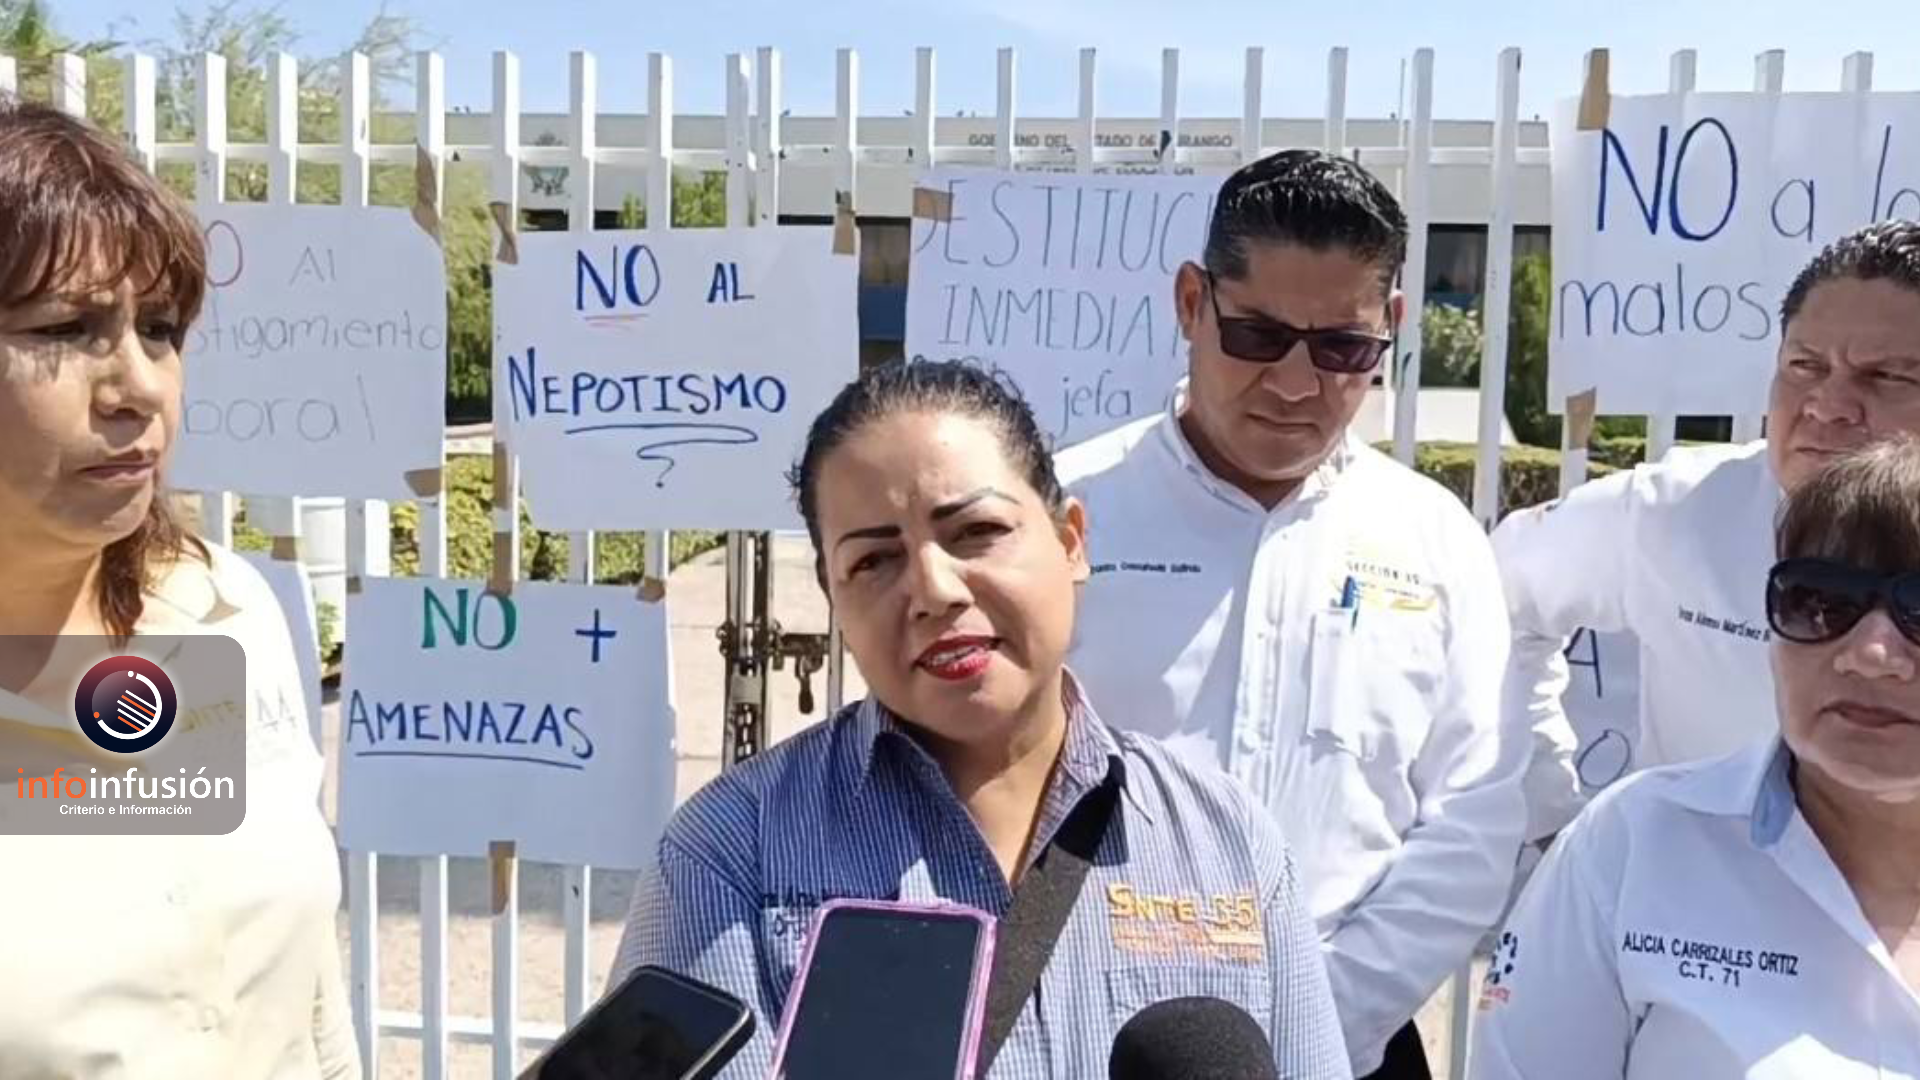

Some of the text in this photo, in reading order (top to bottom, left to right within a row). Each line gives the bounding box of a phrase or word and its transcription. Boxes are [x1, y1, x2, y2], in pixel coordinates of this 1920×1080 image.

[1597, 117, 1738, 241] NO
[1771, 178, 1814, 243] a
[204, 220, 243, 288] O
[576, 244, 755, 311] NO AL
[1559, 262, 1771, 341] malos
[184, 373, 376, 442] boral
[508, 346, 787, 422] NEPOTISMO
[421, 586, 517, 650] NO
[346, 689, 594, 760] AMENAZAS
[1622, 931, 1799, 976] ALICIA CARRIZALES ORTIZ
[1678, 960, 1741, 988] C.T. 71
